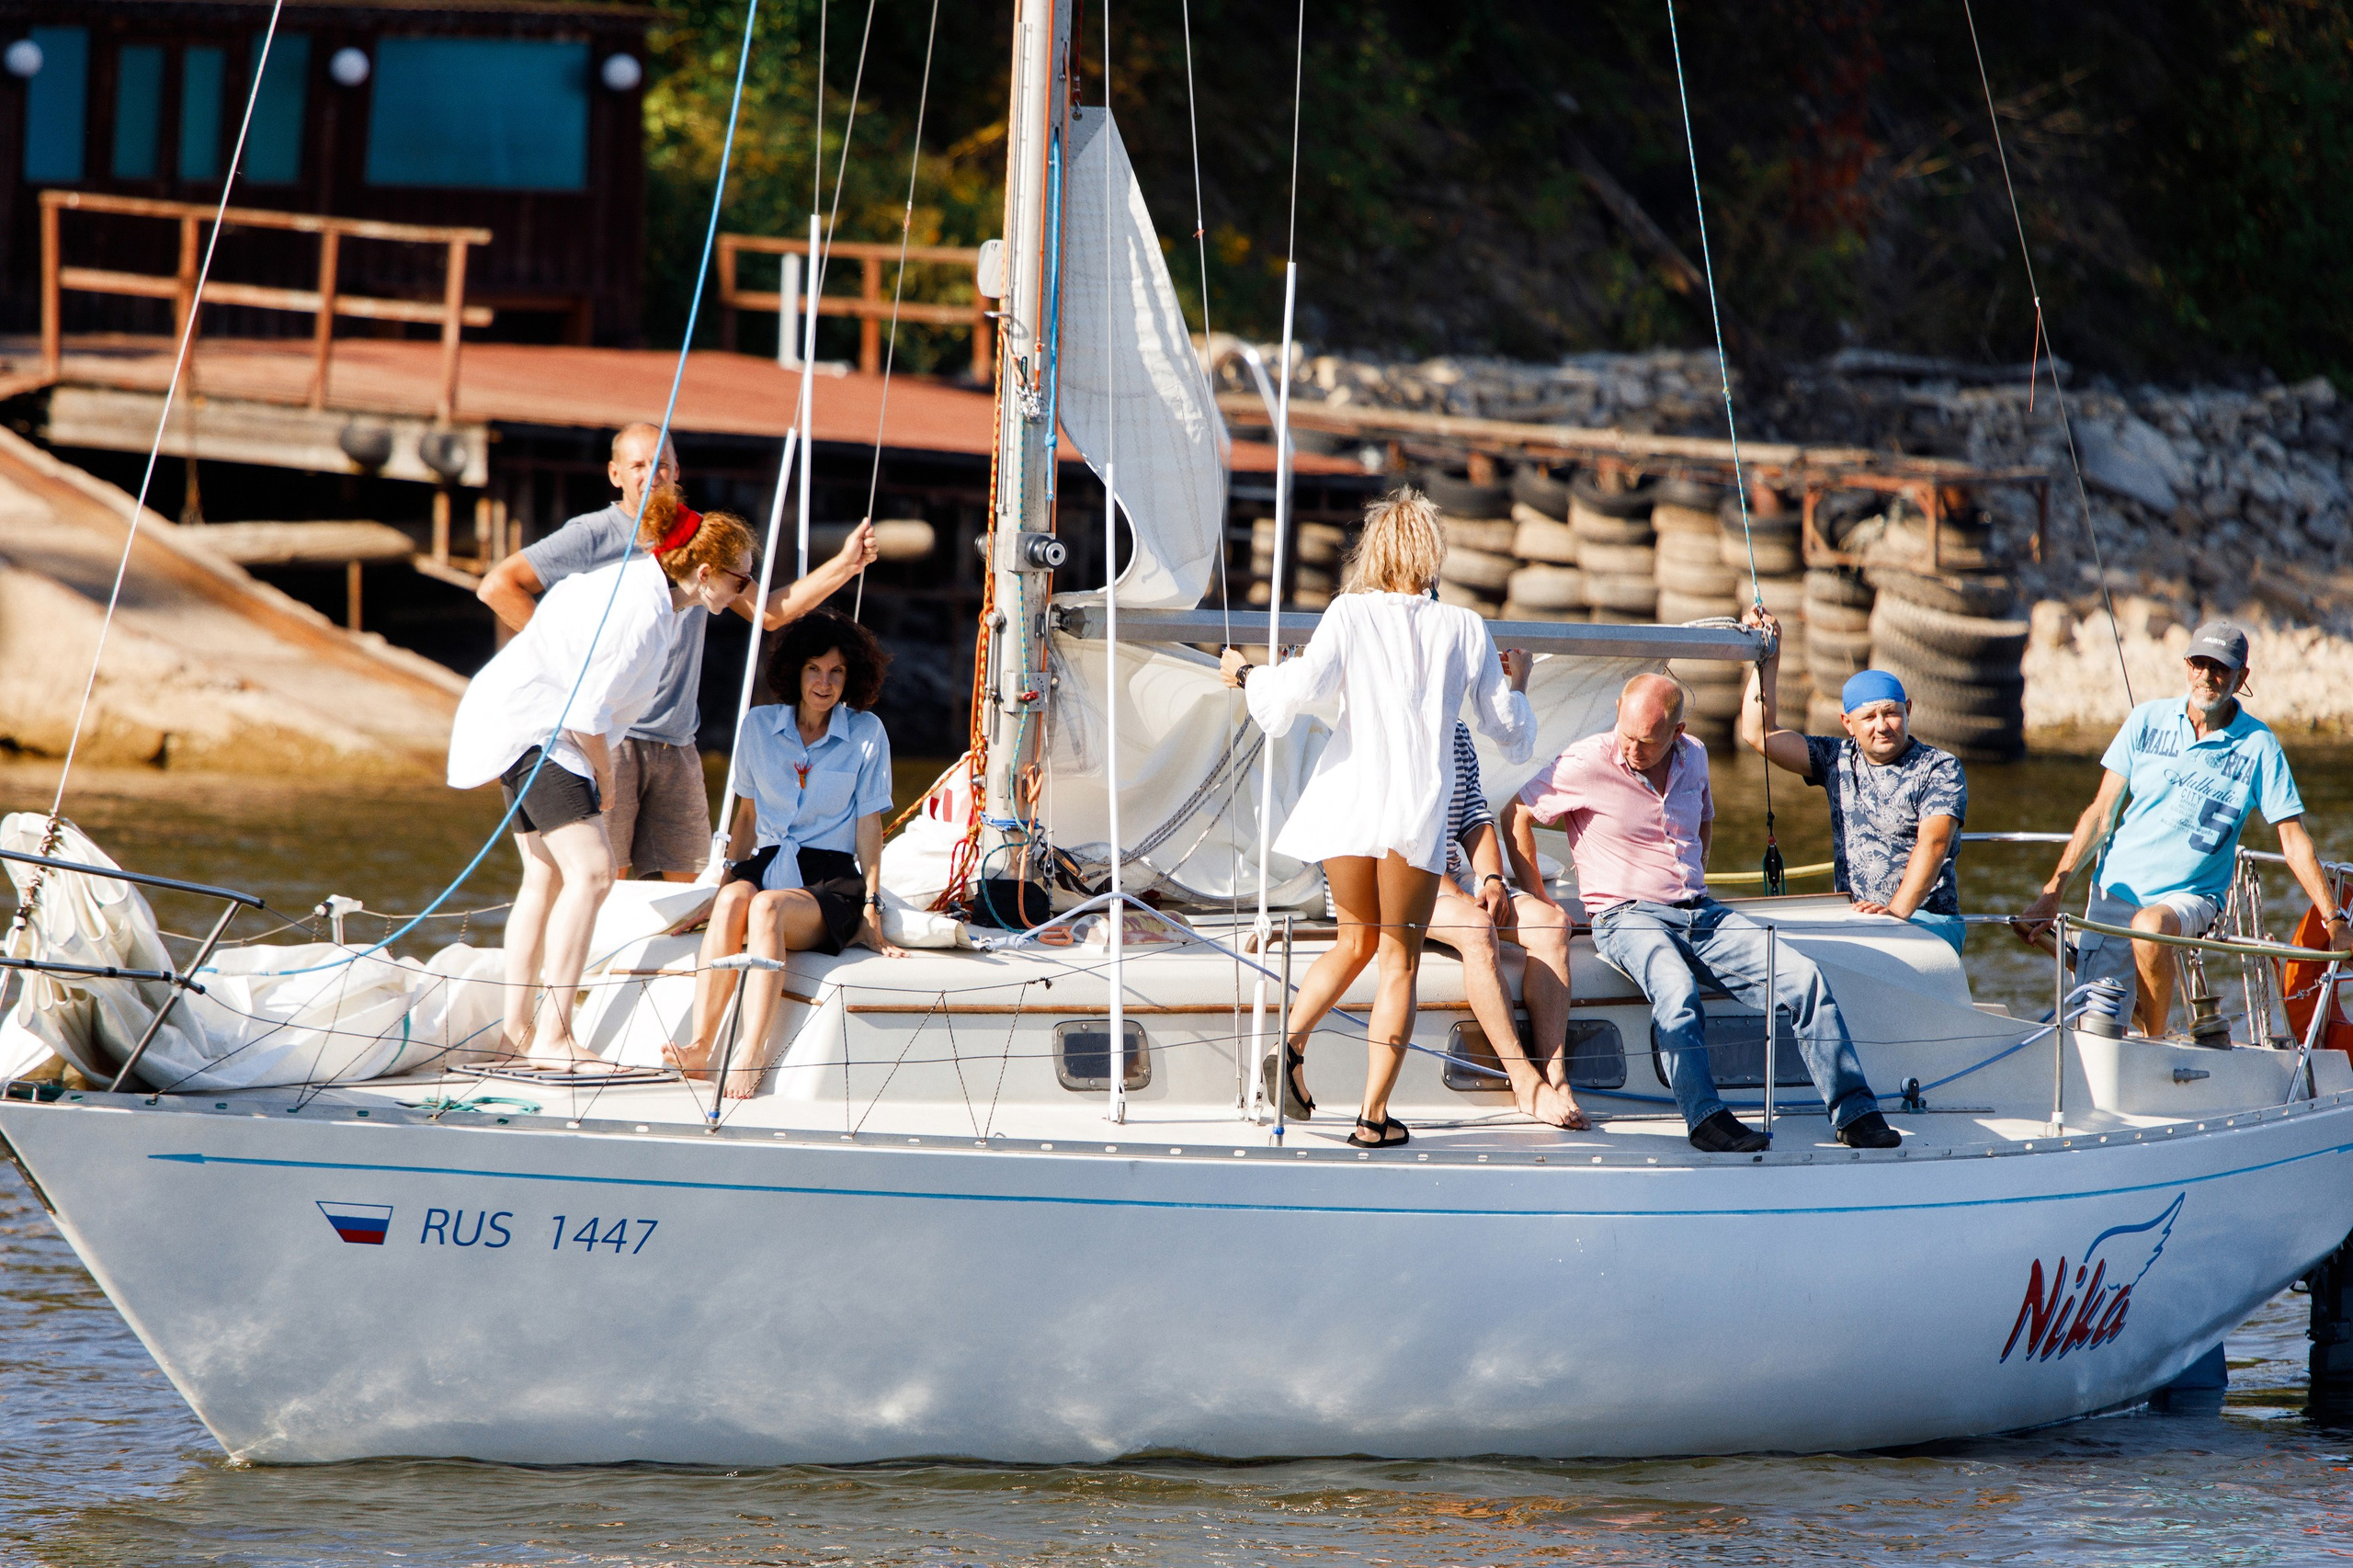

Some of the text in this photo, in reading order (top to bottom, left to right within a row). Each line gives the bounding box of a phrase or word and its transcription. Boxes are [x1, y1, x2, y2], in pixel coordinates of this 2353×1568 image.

[2202, 636, 2226, 646] MUSTO
[2136, 726, 2178, 757] MALL
[2164, 768, 2240, 805] Authentic
[2181, 788, 2203, 804] CITY
[2188, 798, 2241, 855] 5
[420, 1208, 659, 1255] RUS 1447
[1999, 1256, 2131, 1364] Nika
